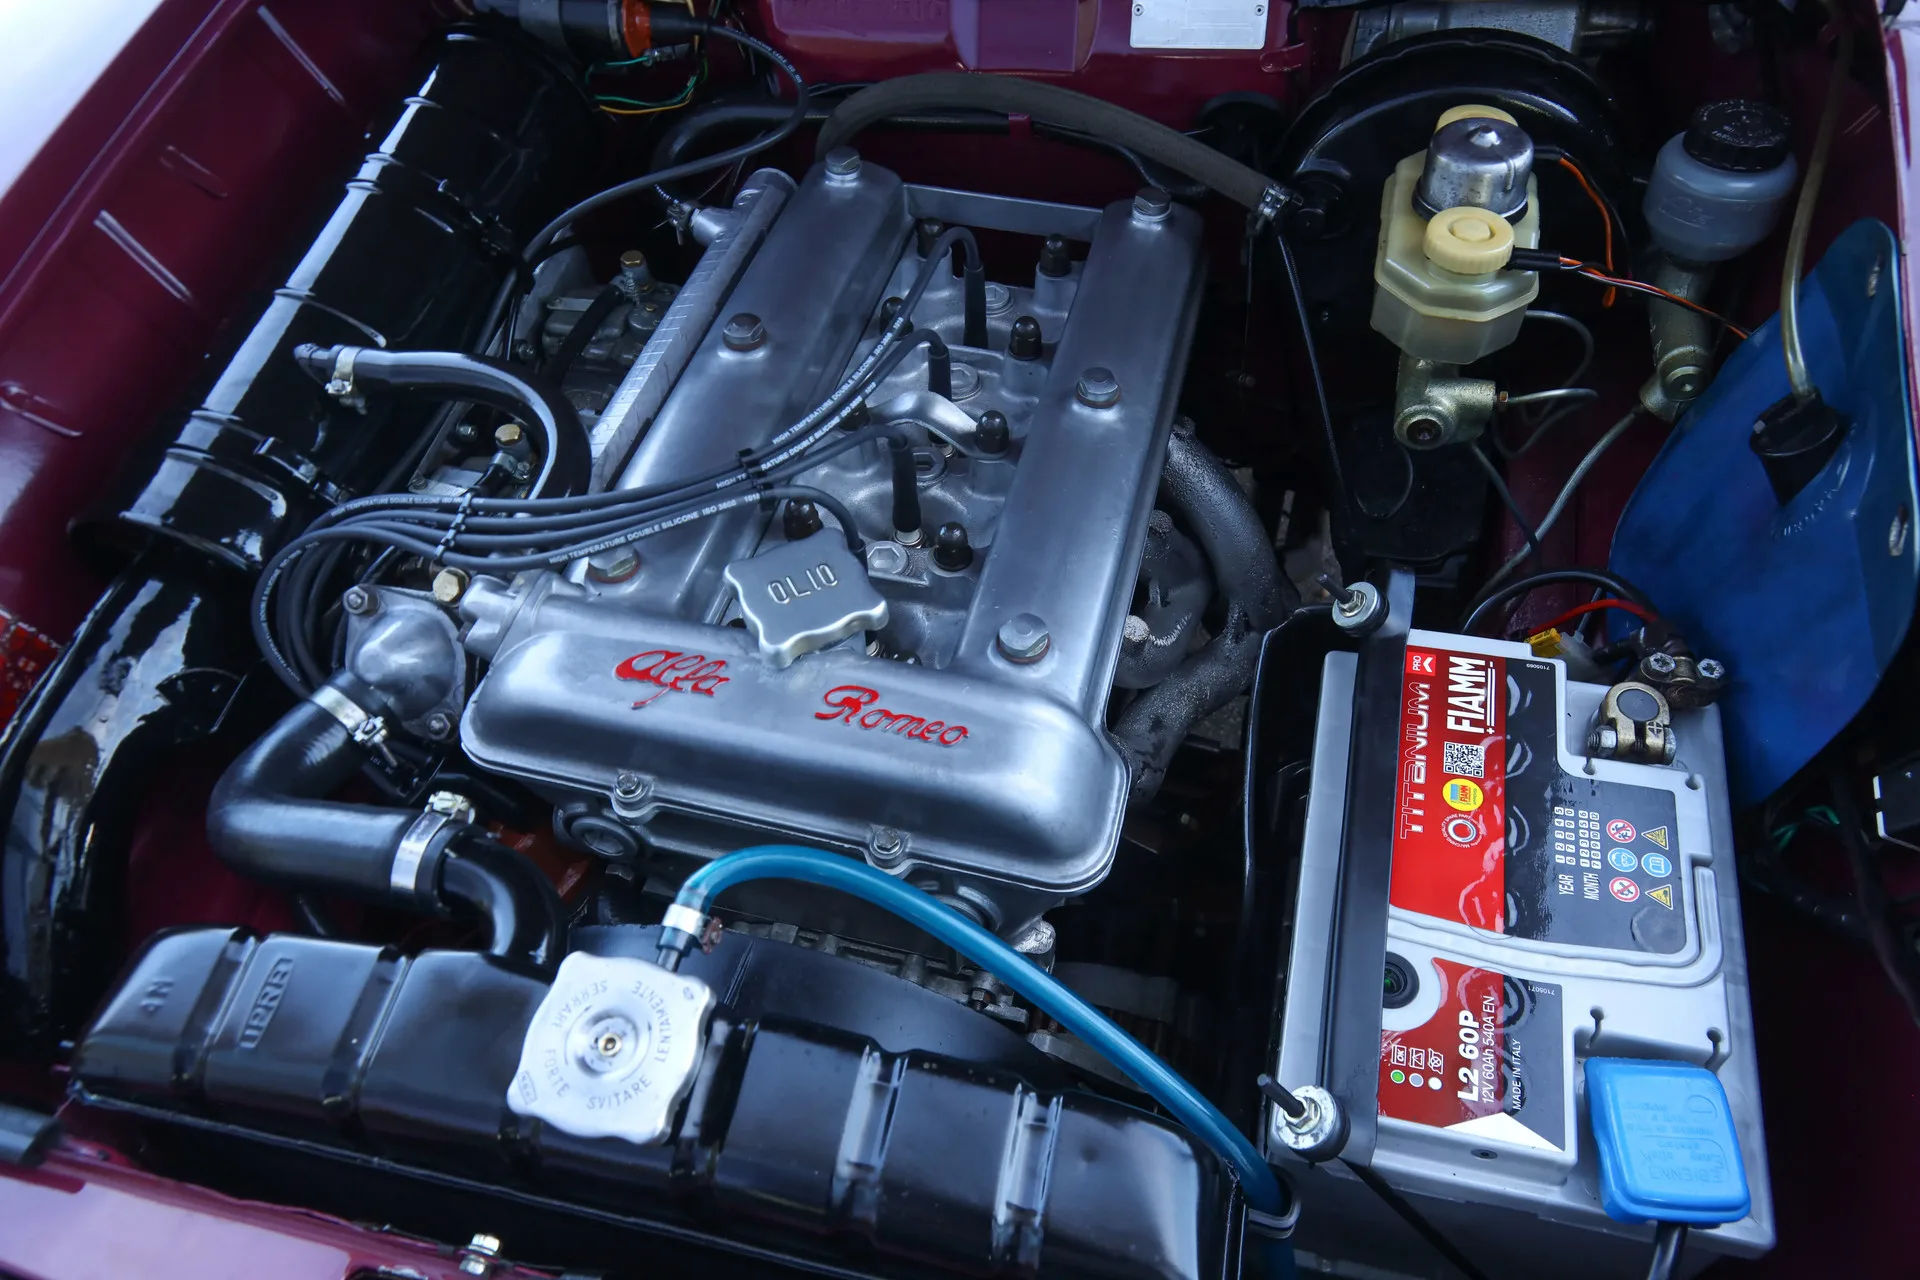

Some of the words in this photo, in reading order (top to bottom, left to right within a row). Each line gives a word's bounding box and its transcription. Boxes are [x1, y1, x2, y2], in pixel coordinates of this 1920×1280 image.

[771, 431, 791, 445] HIGH
[790, 398, 834, 433] TEMPERATURE
[831, 379, 855, 402] DOUBLE
[852, 355, 876, 381] SILICONE
[873, 343, 885, 356] ISO
[715, 476, 737, 489] HIGH
[788, 435, 815, 456] DOUBLE
[814, 415, 841, 439] SILICONE
[840, 404, 852, 419] ISO
[548, 552, 569, 565] HIGH
[568, 535, 627, 560] TEMPERATURE
[627, 523, 661, 542] DOUBLE
[660, 511, 700, 530] SILICONE
[701, 504, 718, 517] ISO
[767, 563, 838, 605] OLIO
[1412, 655, 1422, 672] PRO
[613, 649, 731, 710] Alfa
[814, 684, 971, 746] Romeo
[1446, 656, 1486, 734] FIAMM
[1558, 873, 1575, 895] YEAR
[1583, 871, 1600, 901] MONTH
[1483, 996, 1496, 1014] EN
[631, 980, 673, 1064] LENTAMENTE
[1458, 1009, 1479, 1060] 60P
[1483, 1016, 1495, 1046] 540A
[1397, 1049, 1404, 1062] OK
[1482, 1047, 1495, 1080] 60Ah
[1512, 1039, 1522, 1066] ITALY
[1457, 1066, 1479, 1102] L2
[1512, 1066, 1522, 1078] IN
[586, 1074, 653, 1111] SVITARE
[1481, 1080, 1495, 1104] 12V
[1512, 1079, 1522, 1110] MADE
